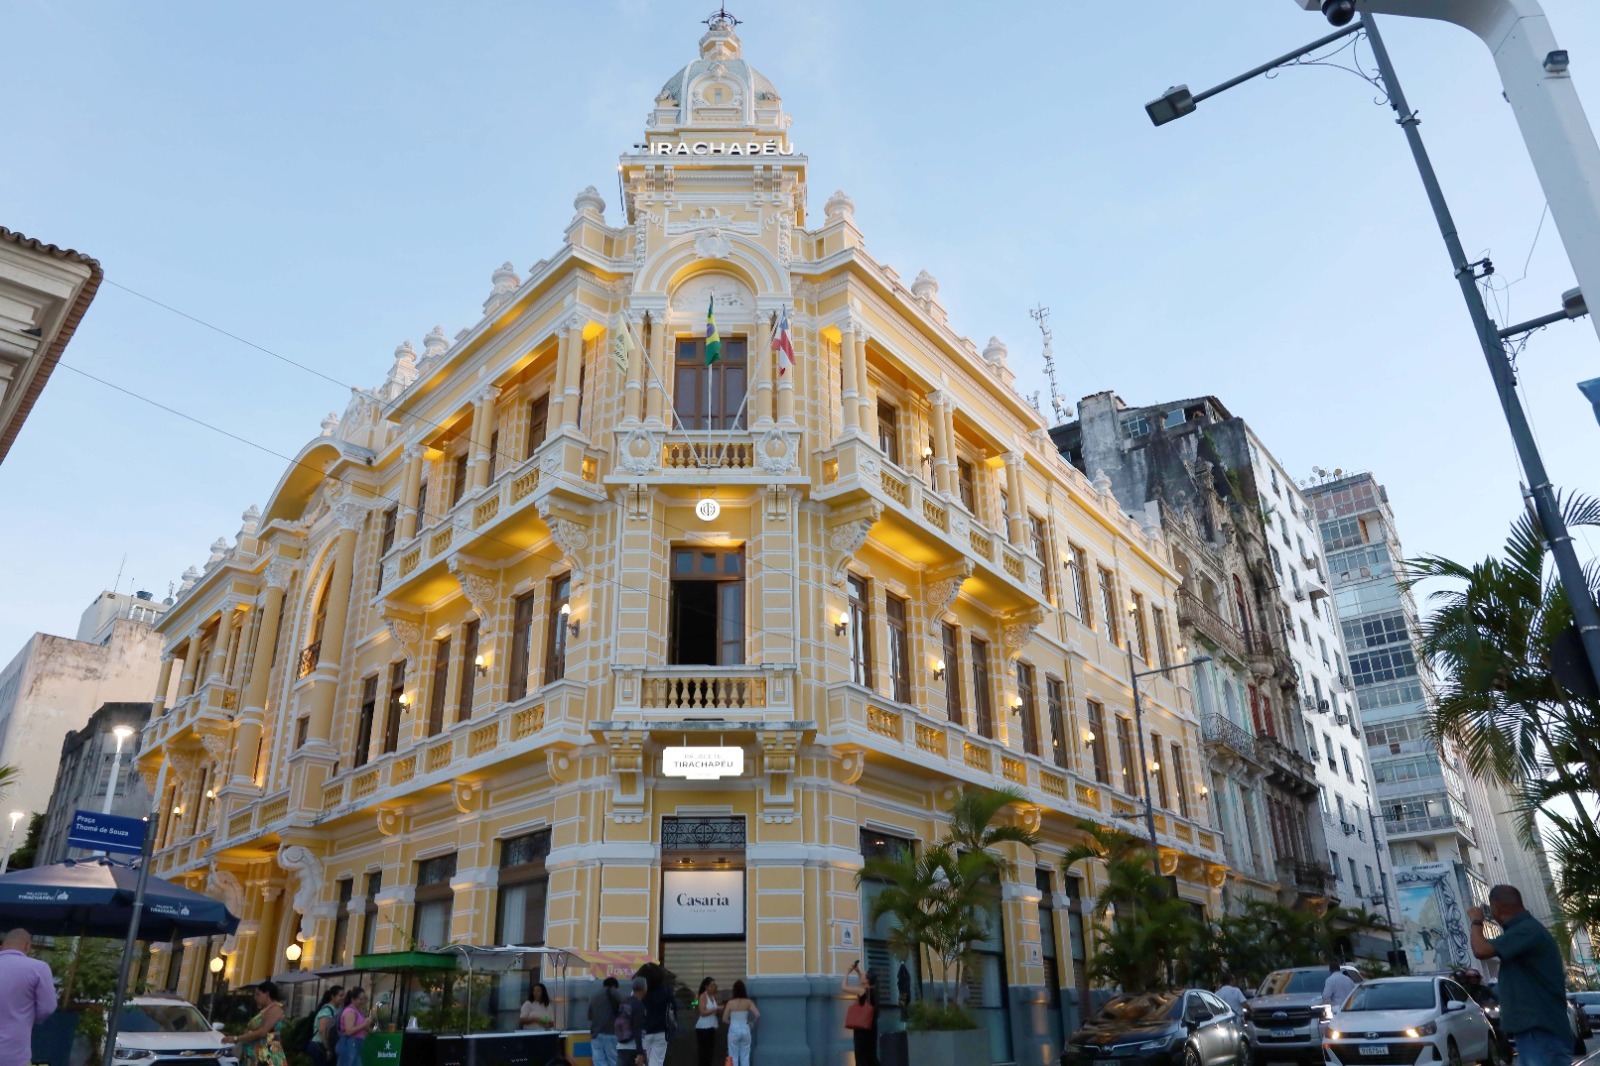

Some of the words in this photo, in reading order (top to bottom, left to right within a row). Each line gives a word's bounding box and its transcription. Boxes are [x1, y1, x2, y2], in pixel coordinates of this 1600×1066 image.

[633, 140, 794, 156] TIRACHAPÉU
[674, 760, 734, 768] TIRACHAPÉU
[76, 816, 95, 824] Praça
[109, 828, 129, 836] Souza
